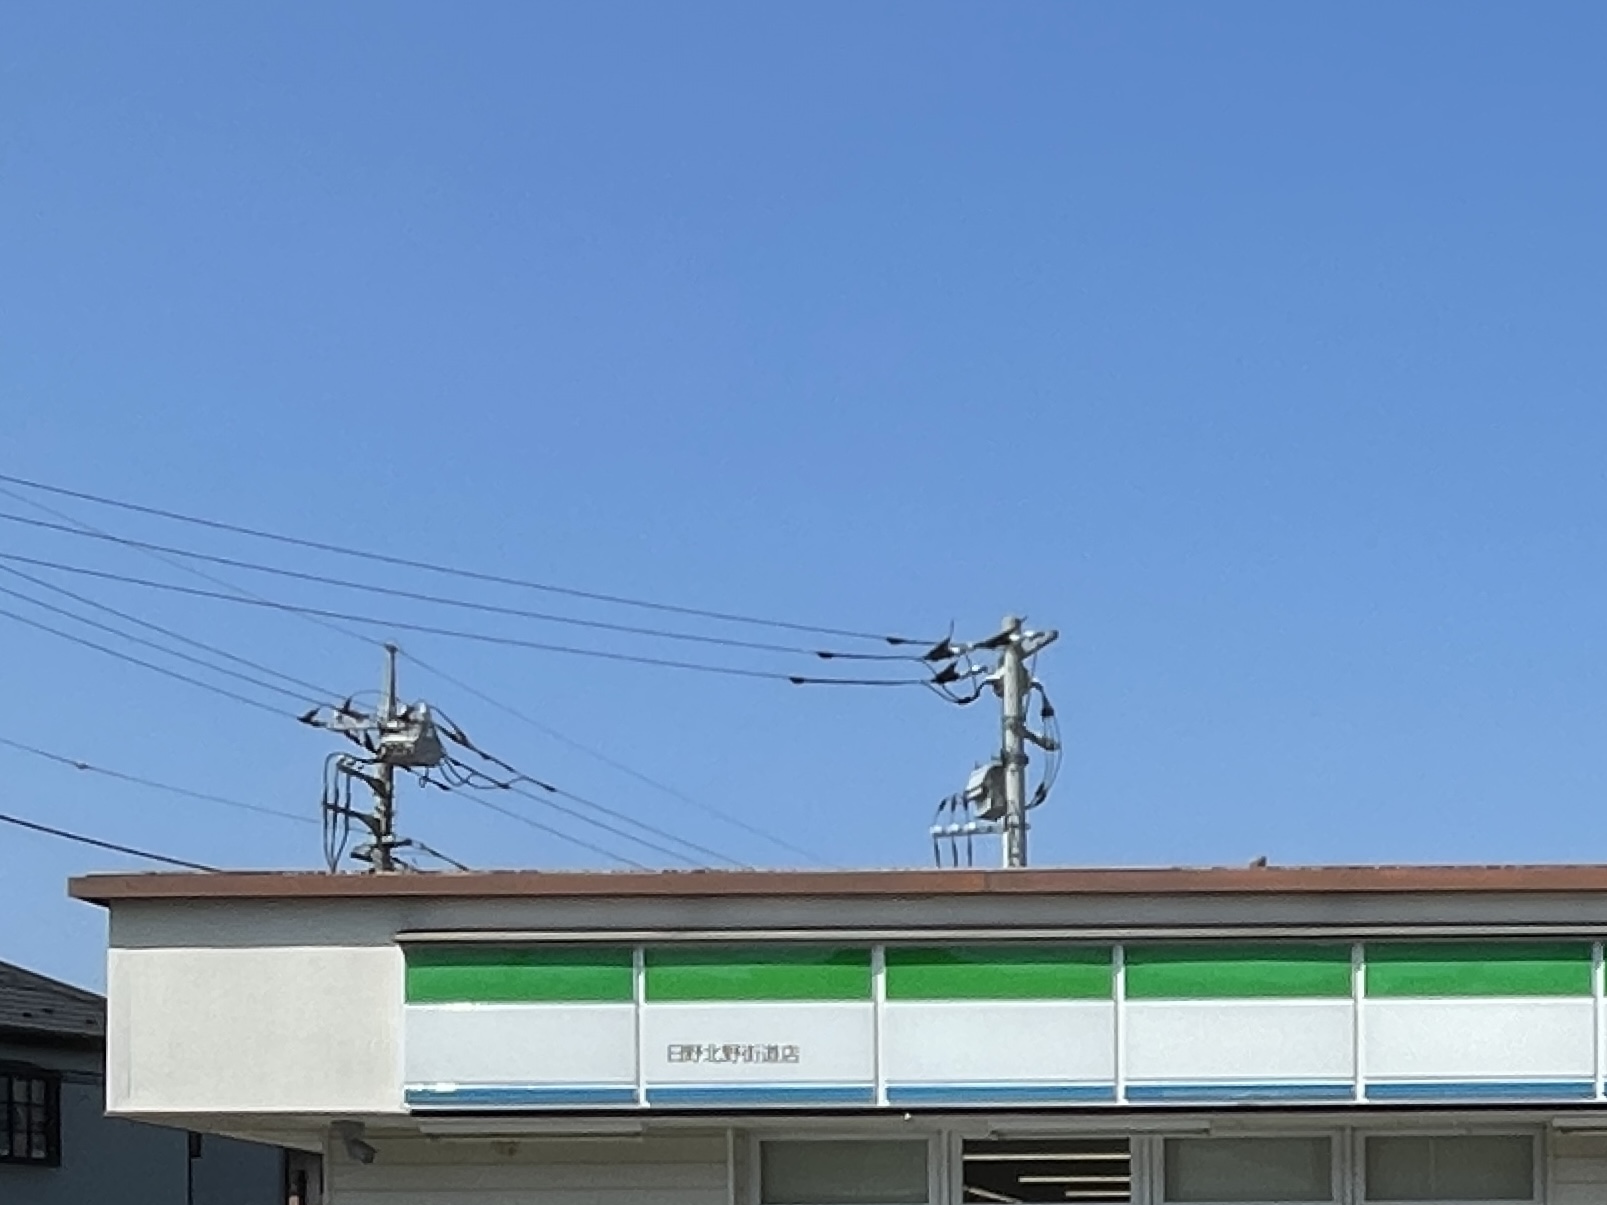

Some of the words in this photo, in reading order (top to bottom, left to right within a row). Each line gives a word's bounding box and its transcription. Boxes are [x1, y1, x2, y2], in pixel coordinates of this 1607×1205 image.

[666, 1043, 800, 1063] 日野北野街道店
